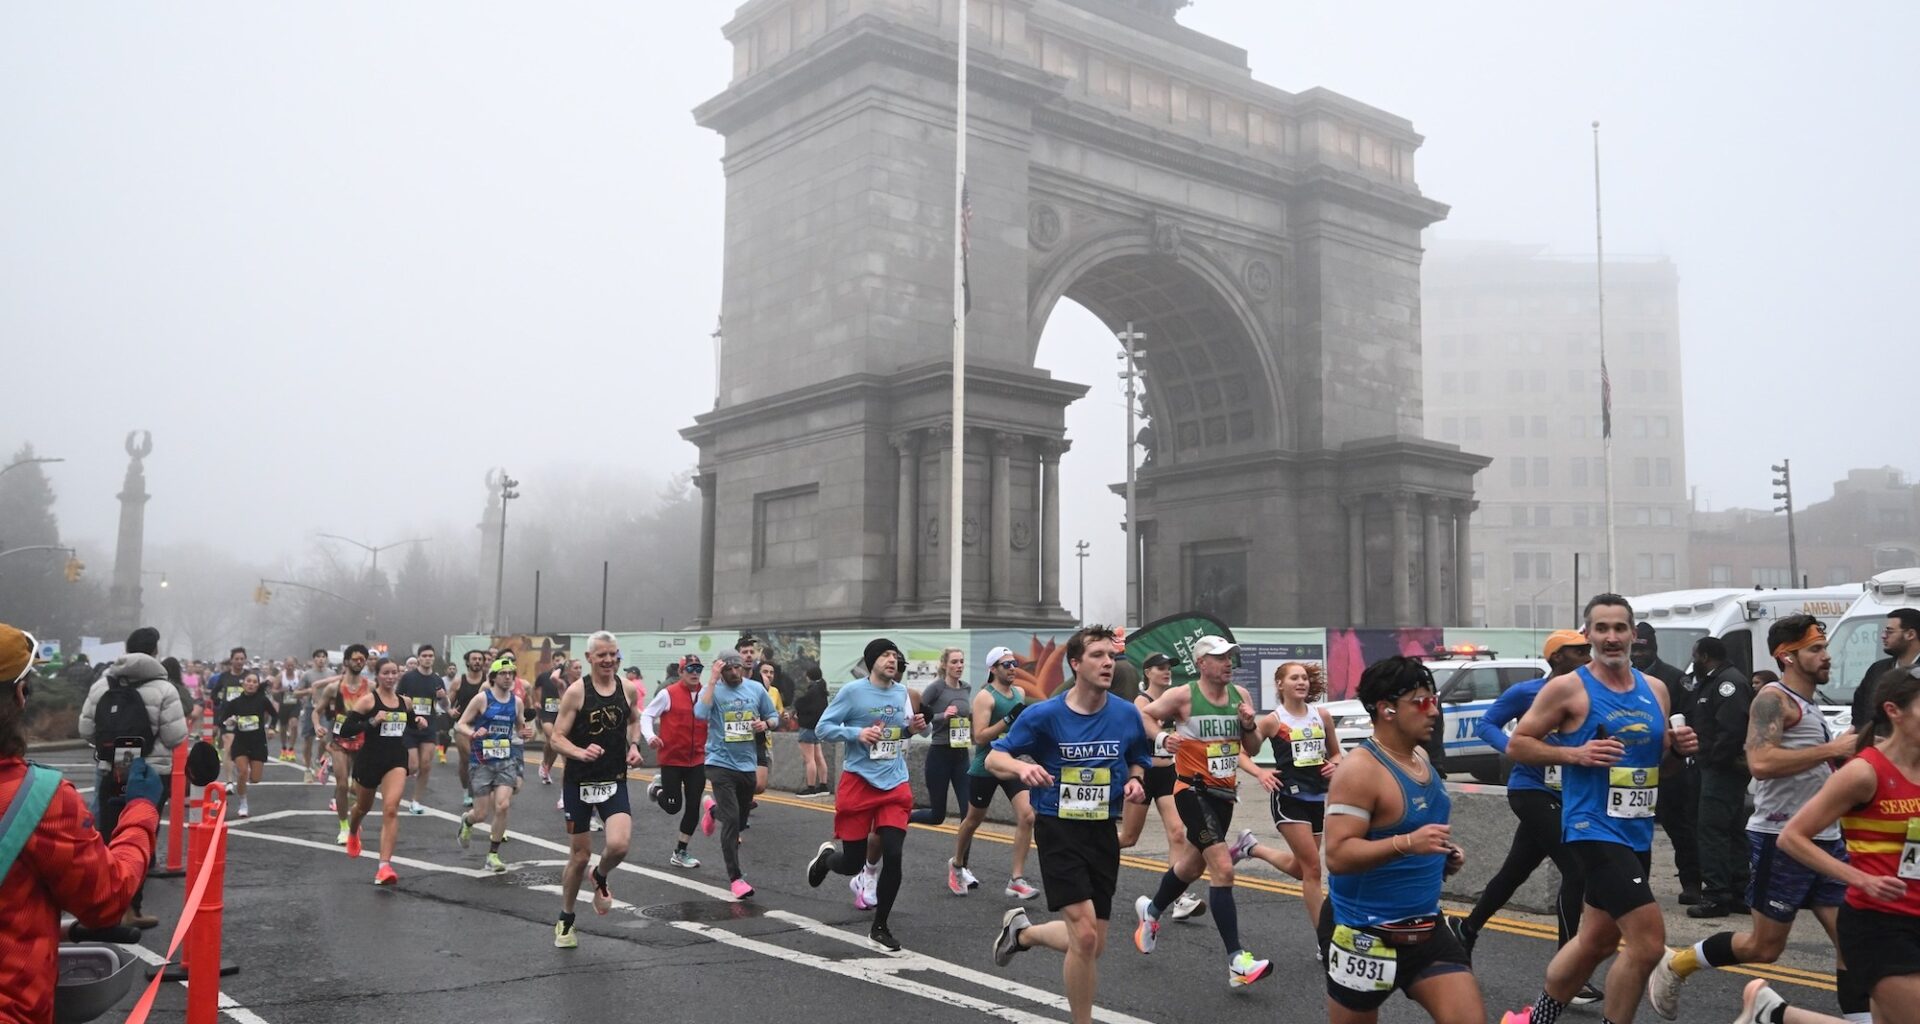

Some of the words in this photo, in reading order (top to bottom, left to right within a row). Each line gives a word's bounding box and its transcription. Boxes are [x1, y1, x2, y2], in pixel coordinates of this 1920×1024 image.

[1200, 719, 1239, 738] IRELAN
[1456, 717, 1482, 739] NY
[1059, 745, 1094, 759] TEAM
[1096, 744, 1119, 757] ALS
[1212, 760, 1218, 770] A
[583, 787, 589, 797] A
[592, 785, 612, 796] 7783
[1062, 787, 1071, 800] A
[1077, 787, 1104, 802] 6874
[1612, 792, 1622, 806] B
[1629, 790, 1654, 807] 2510
[1903, 847, 1916, 864] A
[1330, 950, 1338, 969] A
[1345, 955, 1385, 981] 5931
